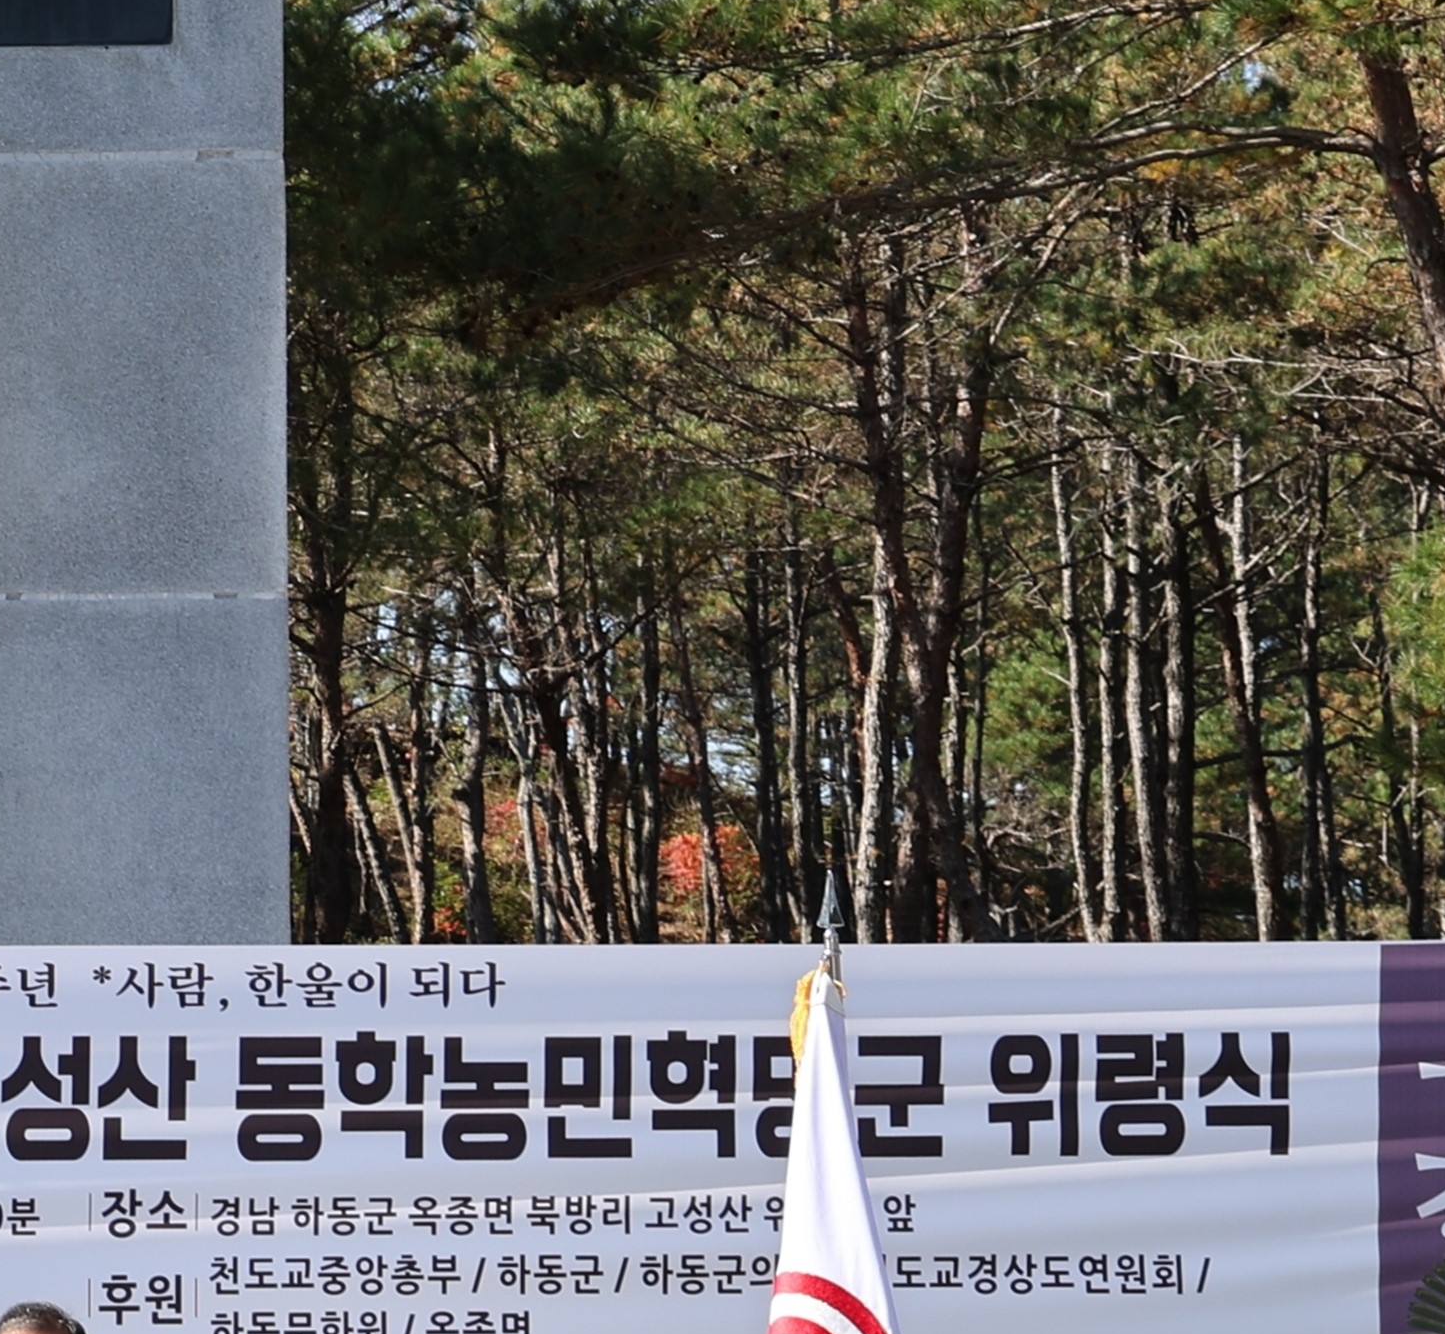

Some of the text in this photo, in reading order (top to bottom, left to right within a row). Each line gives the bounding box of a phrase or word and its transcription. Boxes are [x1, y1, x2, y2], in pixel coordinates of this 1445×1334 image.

[244, 961, 390, 1009] 한울이
[408, 961, 506, 1009] 되다
[987, 1032, 1291, 1156] 위령식
[100, 1189, 189, 1240] 장소
[211, 1195, 276, 1237] 경남
[292, 1194, 398, 1237] 하동군
[408, 1194, 514, 1236] 옥종면
[526, 1194, 632, 1235] 북방리
[644, 1193, 753, 1235] 고성산
[883, 1194, 917, 1233] 앞
[98, 1273, 186, 1326] 후원
[210, 1254, 463, 1296] 천도교중앙총부
[498, 1254, 604, 1295] 하동군
[880, 1252, 1186, 1296] 도교경상도연원회
